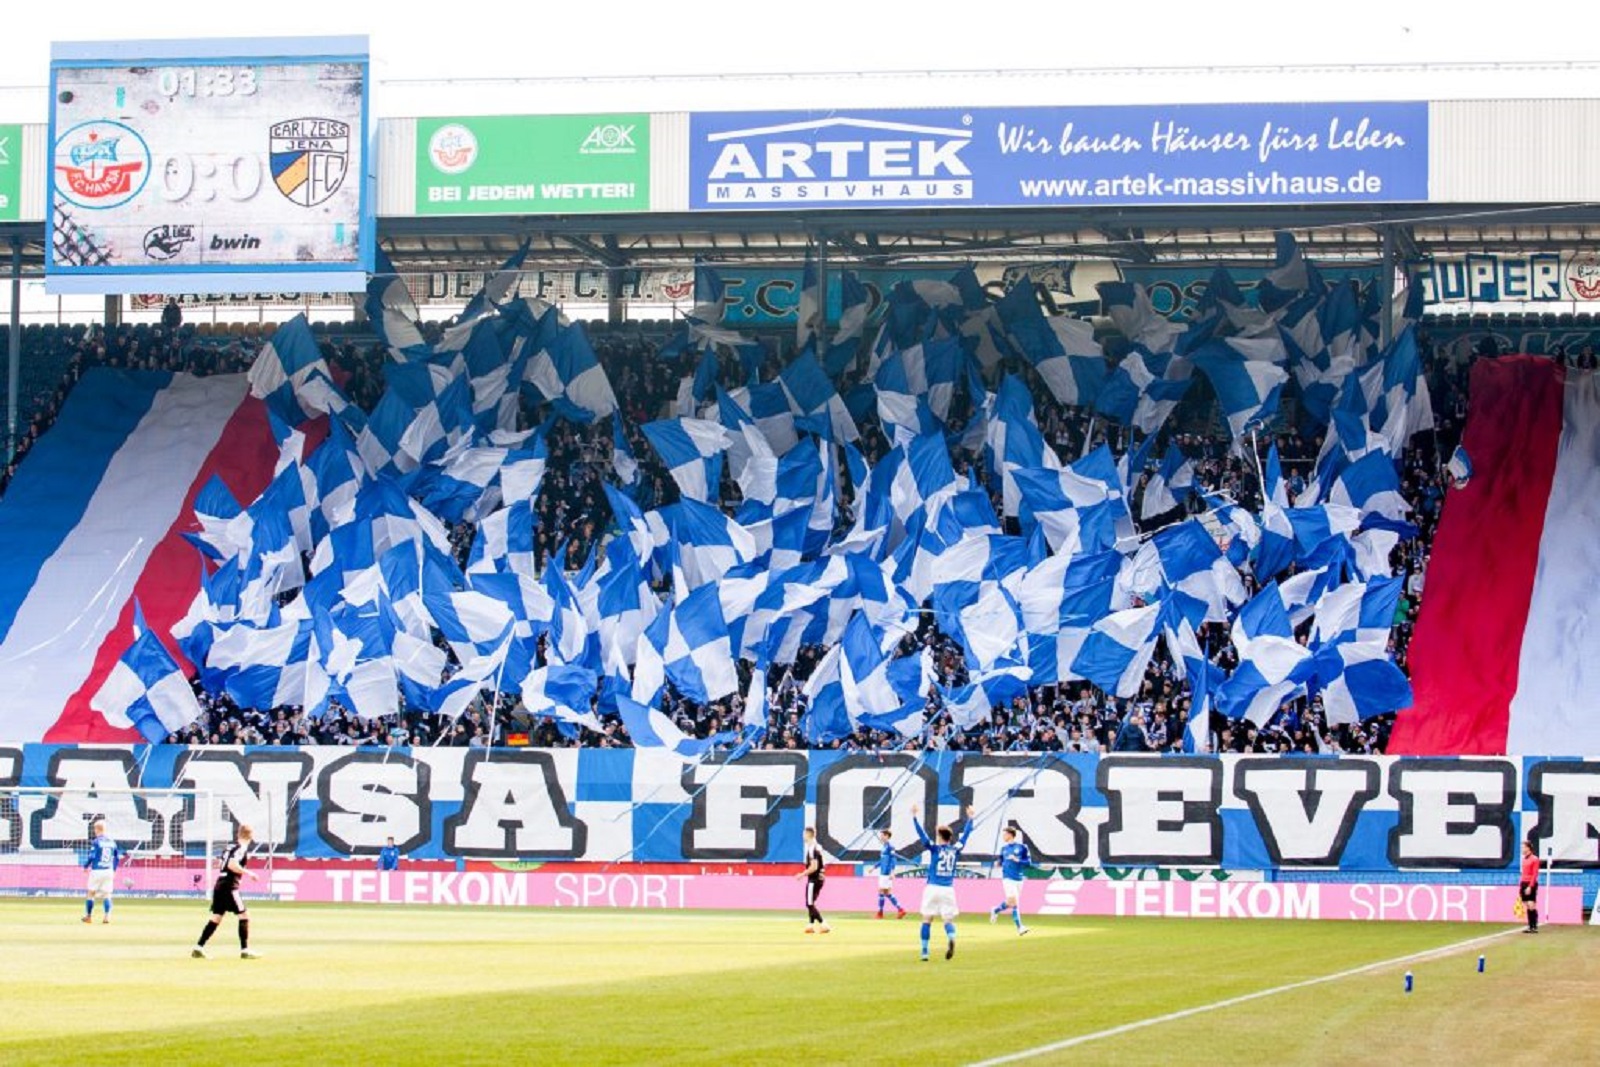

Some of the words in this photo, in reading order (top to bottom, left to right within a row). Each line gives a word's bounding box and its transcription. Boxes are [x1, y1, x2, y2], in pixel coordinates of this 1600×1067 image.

[159, 70, 258, 98] 01:33
[273, 121, 307, 139] CARL
[308, 120, 348, 138] ZEISS
[582, 125, 636, 147] AOK
[998, 122, 1052, 156] Wir
[1061, 122, 1142, 157] bauen
[1152, 120, 1251, 155] Häuser
[1259, 122, 1319, 163] fürs
[1328, 117, 1406, 151] Leben
[286, 139, 334, 150] JENA
[708, 140, 972, 180] ARTEK
[163, 152, 263, 203] 0:0
[312, 153, 346, 202] FC
[1020, 170, 1382, 198] www.artek-massivhaus.de
[428, 186, 461, 202] BEI
[467, 184, 534, 201] JEDEM
[541, 182, 636, 199] WETTER!
[716, 184, 964, 200] MASSIVHAUS
[209, 233, 261, 250] bwin
[937, 850, 957, 871] 20
[325, 869, 528, 906] TELEKOM
[553, 873, 695, 909] SPORT
[1108, 882, 1320, 919] TELEKOM
[1349, 885, 1498, 921] SPORT
